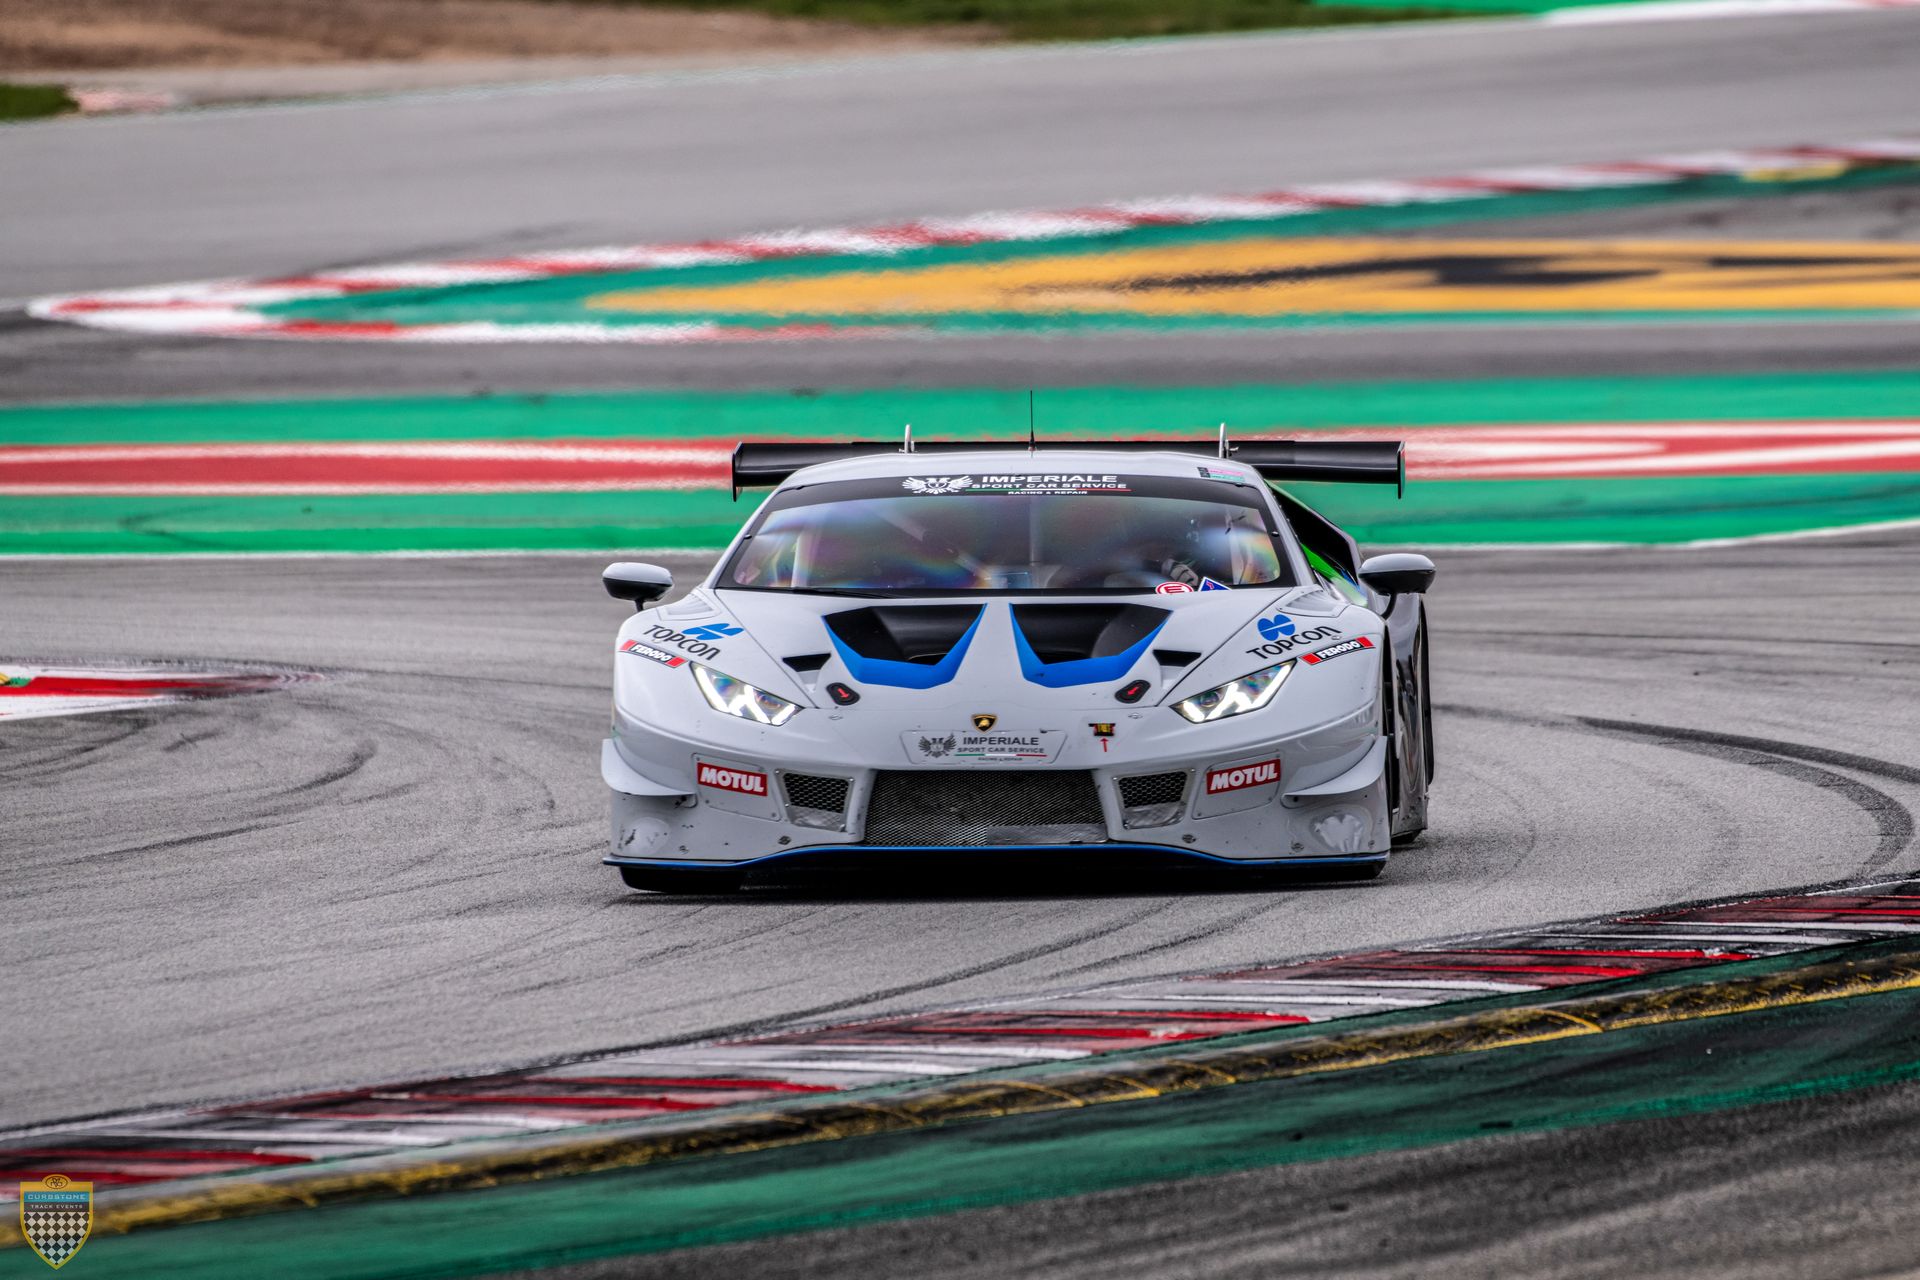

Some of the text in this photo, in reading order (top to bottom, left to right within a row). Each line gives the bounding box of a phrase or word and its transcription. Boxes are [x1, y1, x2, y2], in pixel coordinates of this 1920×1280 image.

[982, 475, 1117, 483] IMPERIALE
[631, 644, 672, 662] FERODO
[643, 625, 721, 661] TOPCON
[1246, 625, 1342, 659] TOPCON
[1316, 641, 1361, 659] FERODO
[963, 736, 1040, 745] IMPERIALE
[700, 766, 764, 792] MOTUL
[1210, 763, 1278, 791] MOTUL
